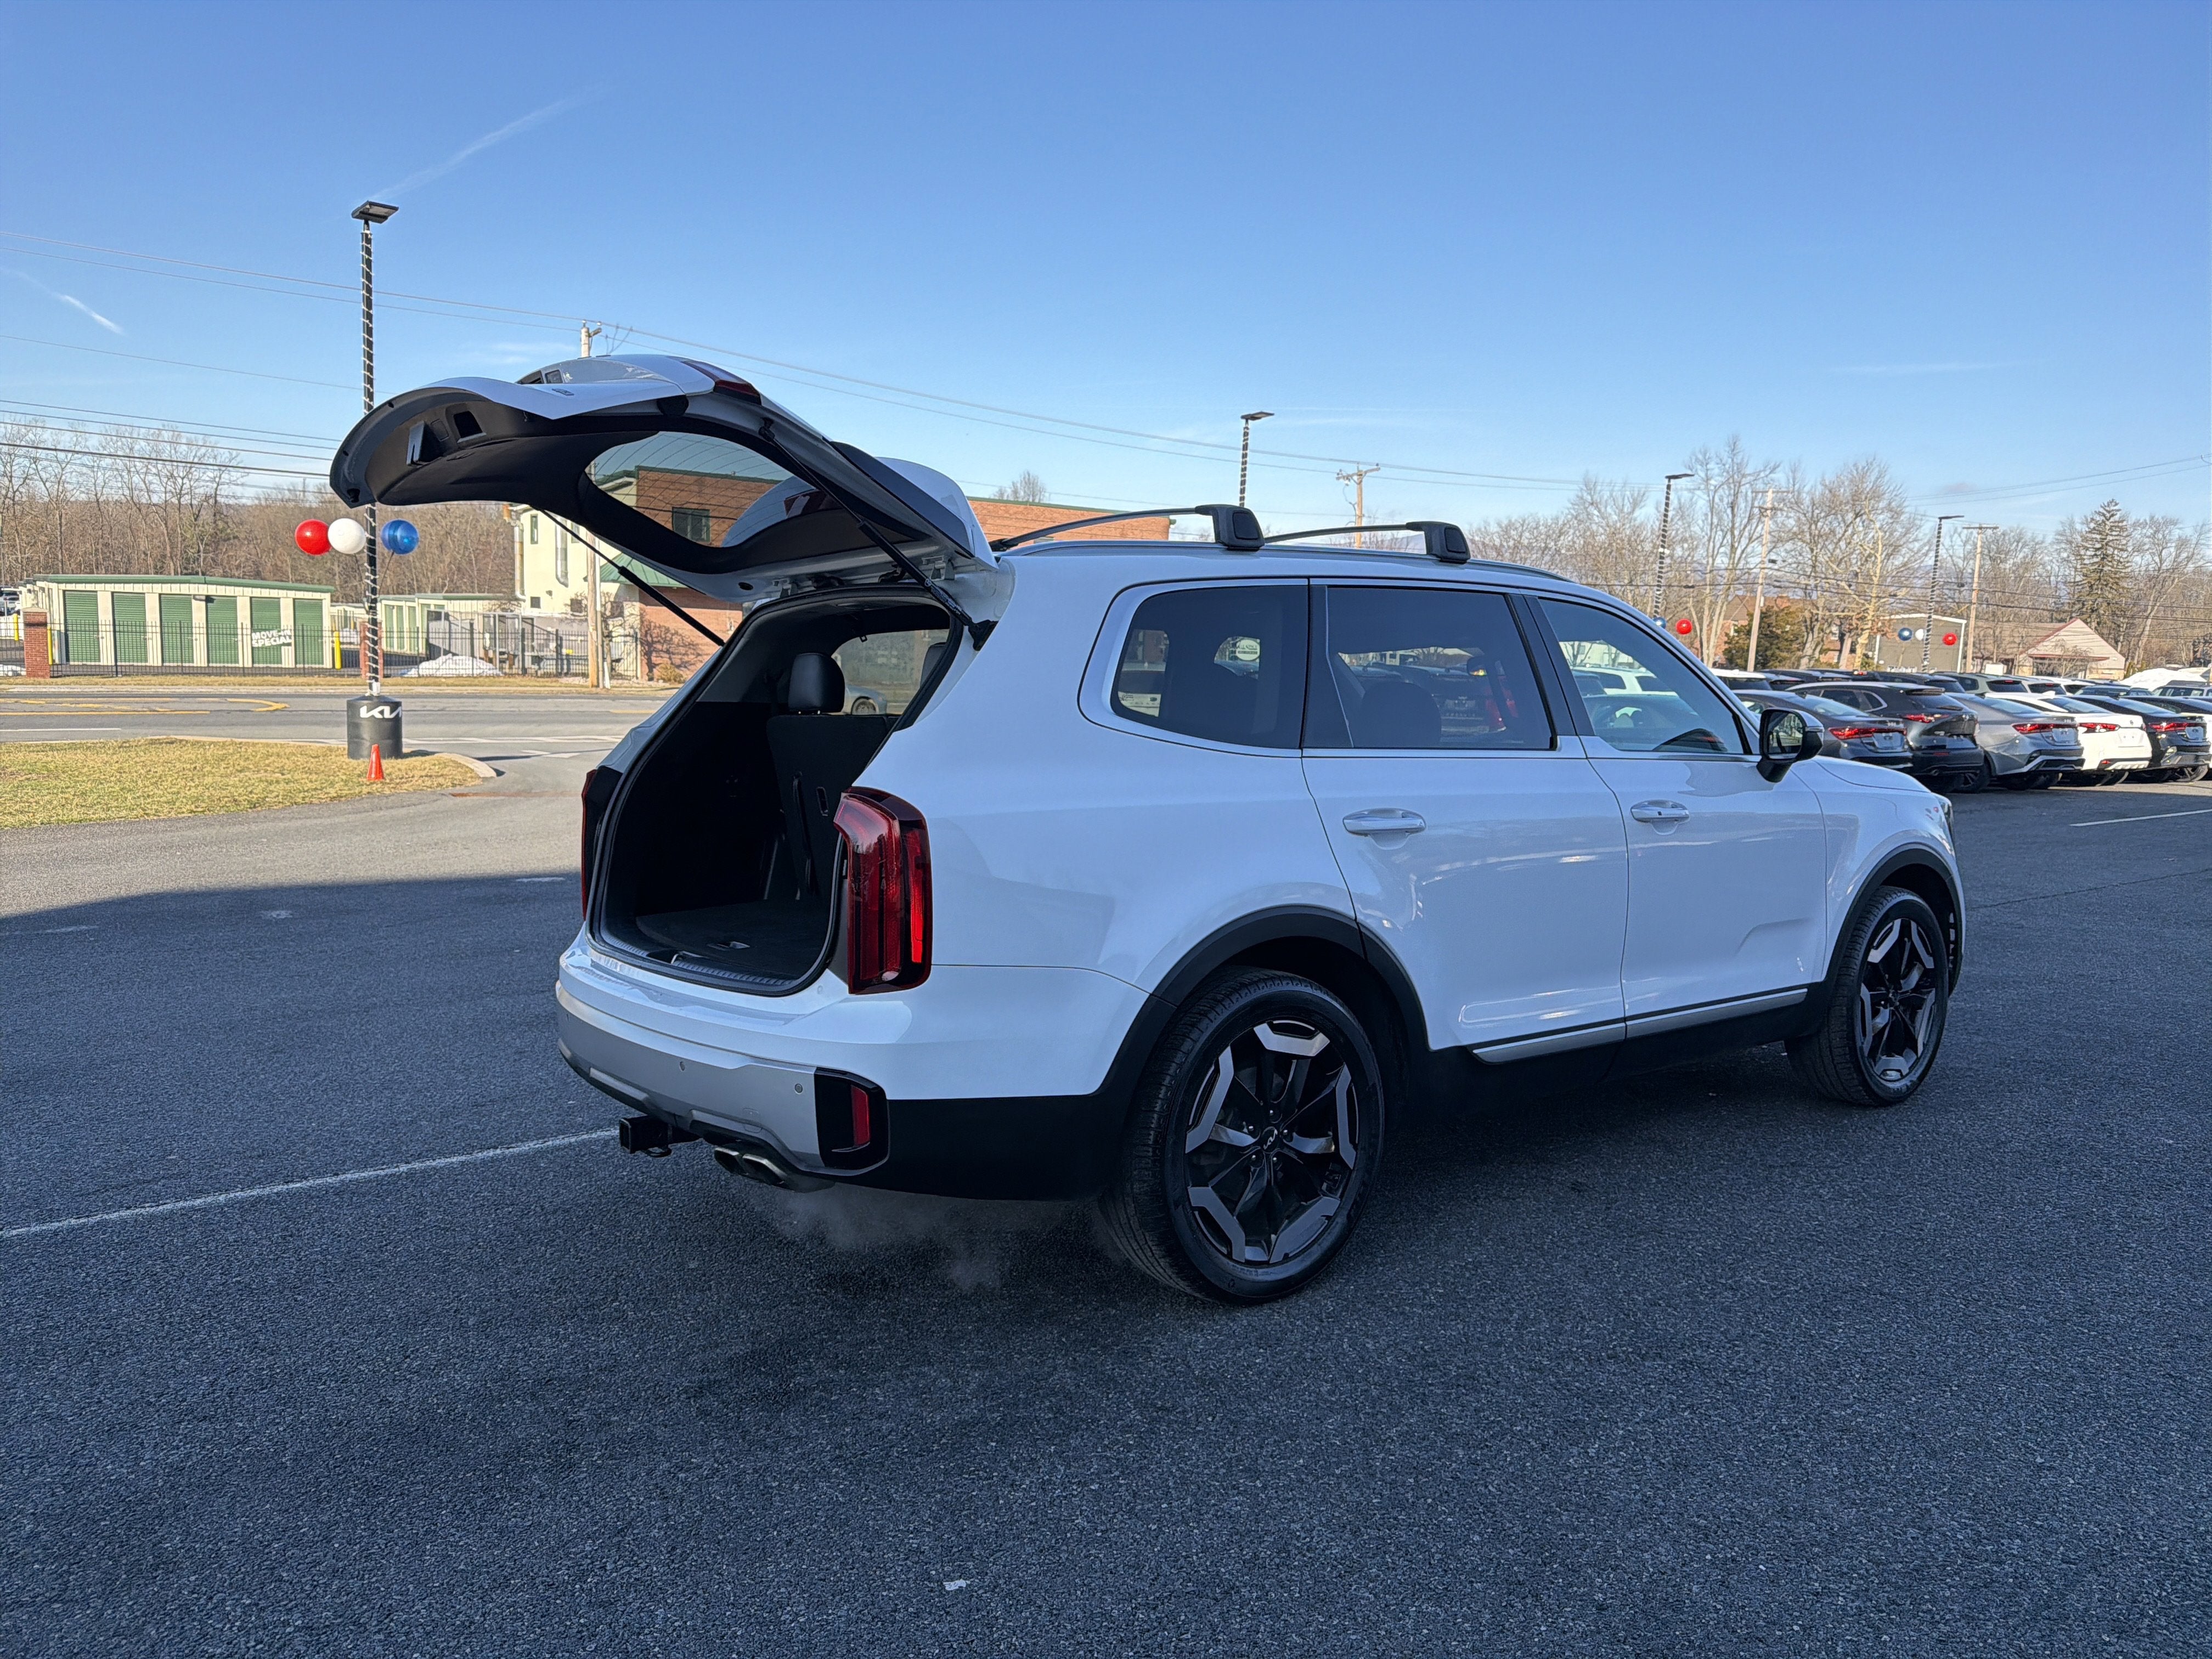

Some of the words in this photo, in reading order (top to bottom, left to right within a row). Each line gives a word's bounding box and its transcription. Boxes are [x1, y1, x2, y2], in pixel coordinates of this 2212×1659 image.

[252, 629, 292, 640] MOVE-IN
[252, 636, 292, 647] SPECIAL
[360, 706, 402, 719] KIA
